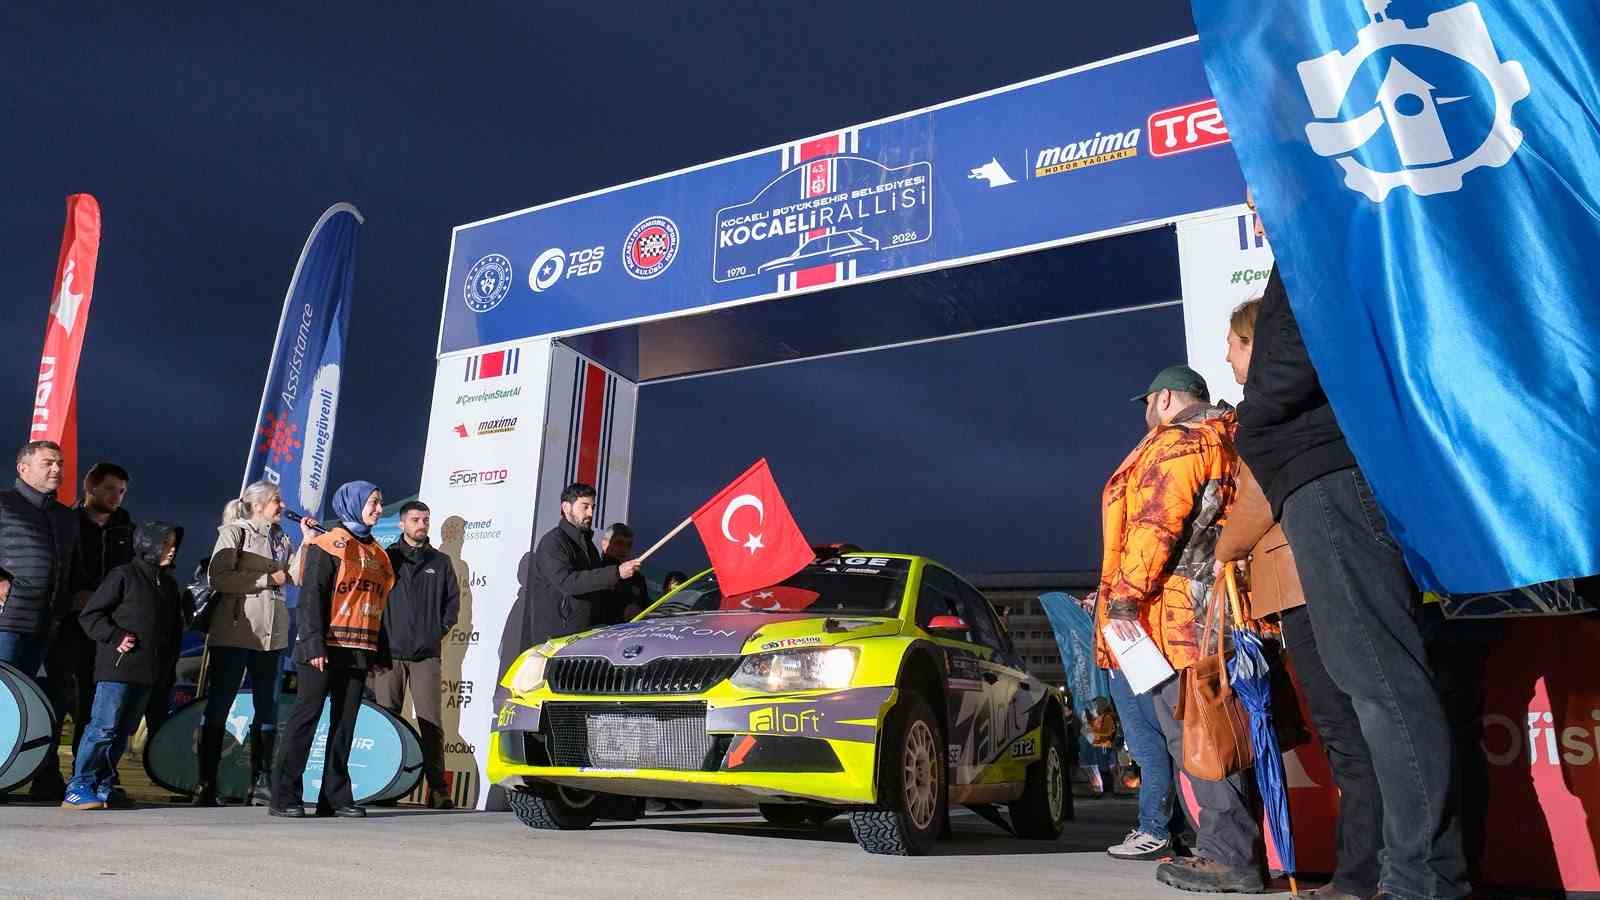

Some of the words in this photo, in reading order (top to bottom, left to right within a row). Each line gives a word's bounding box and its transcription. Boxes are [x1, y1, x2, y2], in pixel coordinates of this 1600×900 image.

[1036, 127, 1141, 168] maxima
[1045, 162, 1078, 175] MOTOR
[892, 231, 918, 245] 2026
[569, 246, 605, 265] TOS
[565, 260, 602, 279] FED
[726, 266, 747, 278] 1970
[281, 303, 313, 410] Assistance
[478, 416, 518, 431] maxima
[447, 695, 472, 709] APP
[749, 704, 820, 732] aloft
